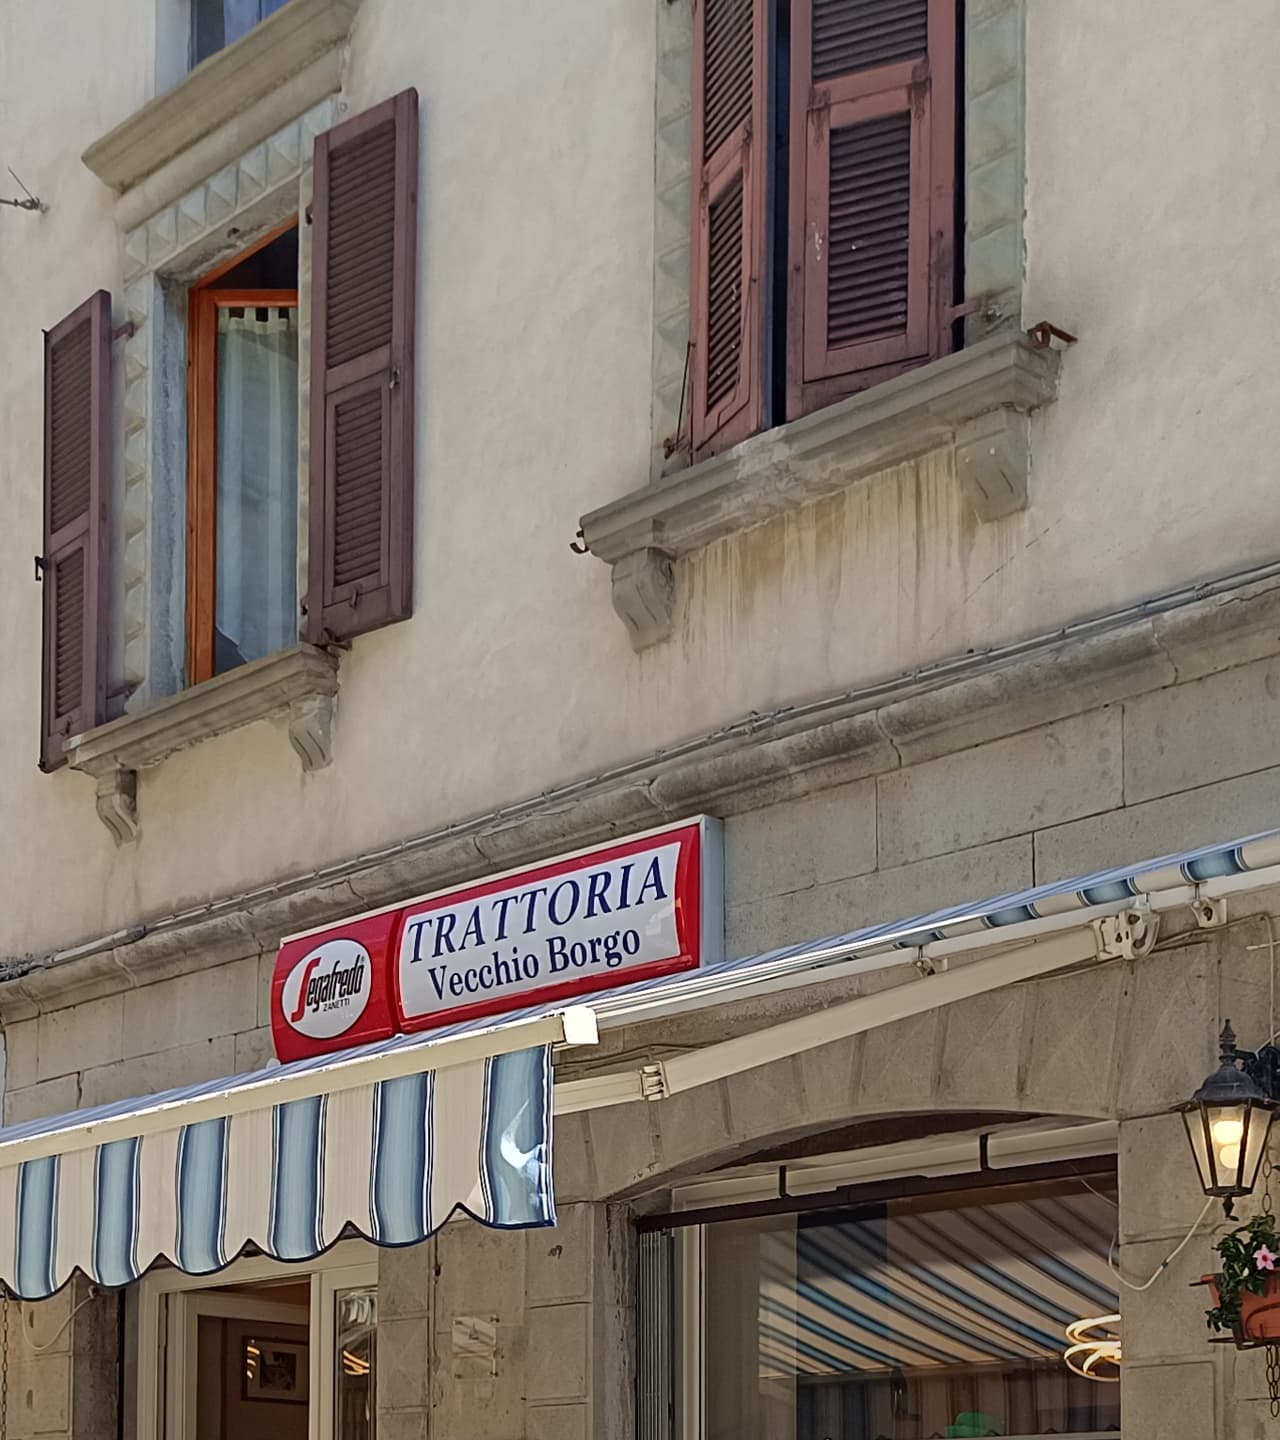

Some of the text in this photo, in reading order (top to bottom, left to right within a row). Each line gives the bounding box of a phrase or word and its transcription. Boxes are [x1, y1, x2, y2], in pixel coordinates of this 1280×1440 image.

[408, 857, 668, 963] TRATTORIA
[291, 954, 365, 1023] Segafredo
[428, 929, 641, 1000] Vecchio Borgo
[323, 998, 350, 1012] ZANETTI
